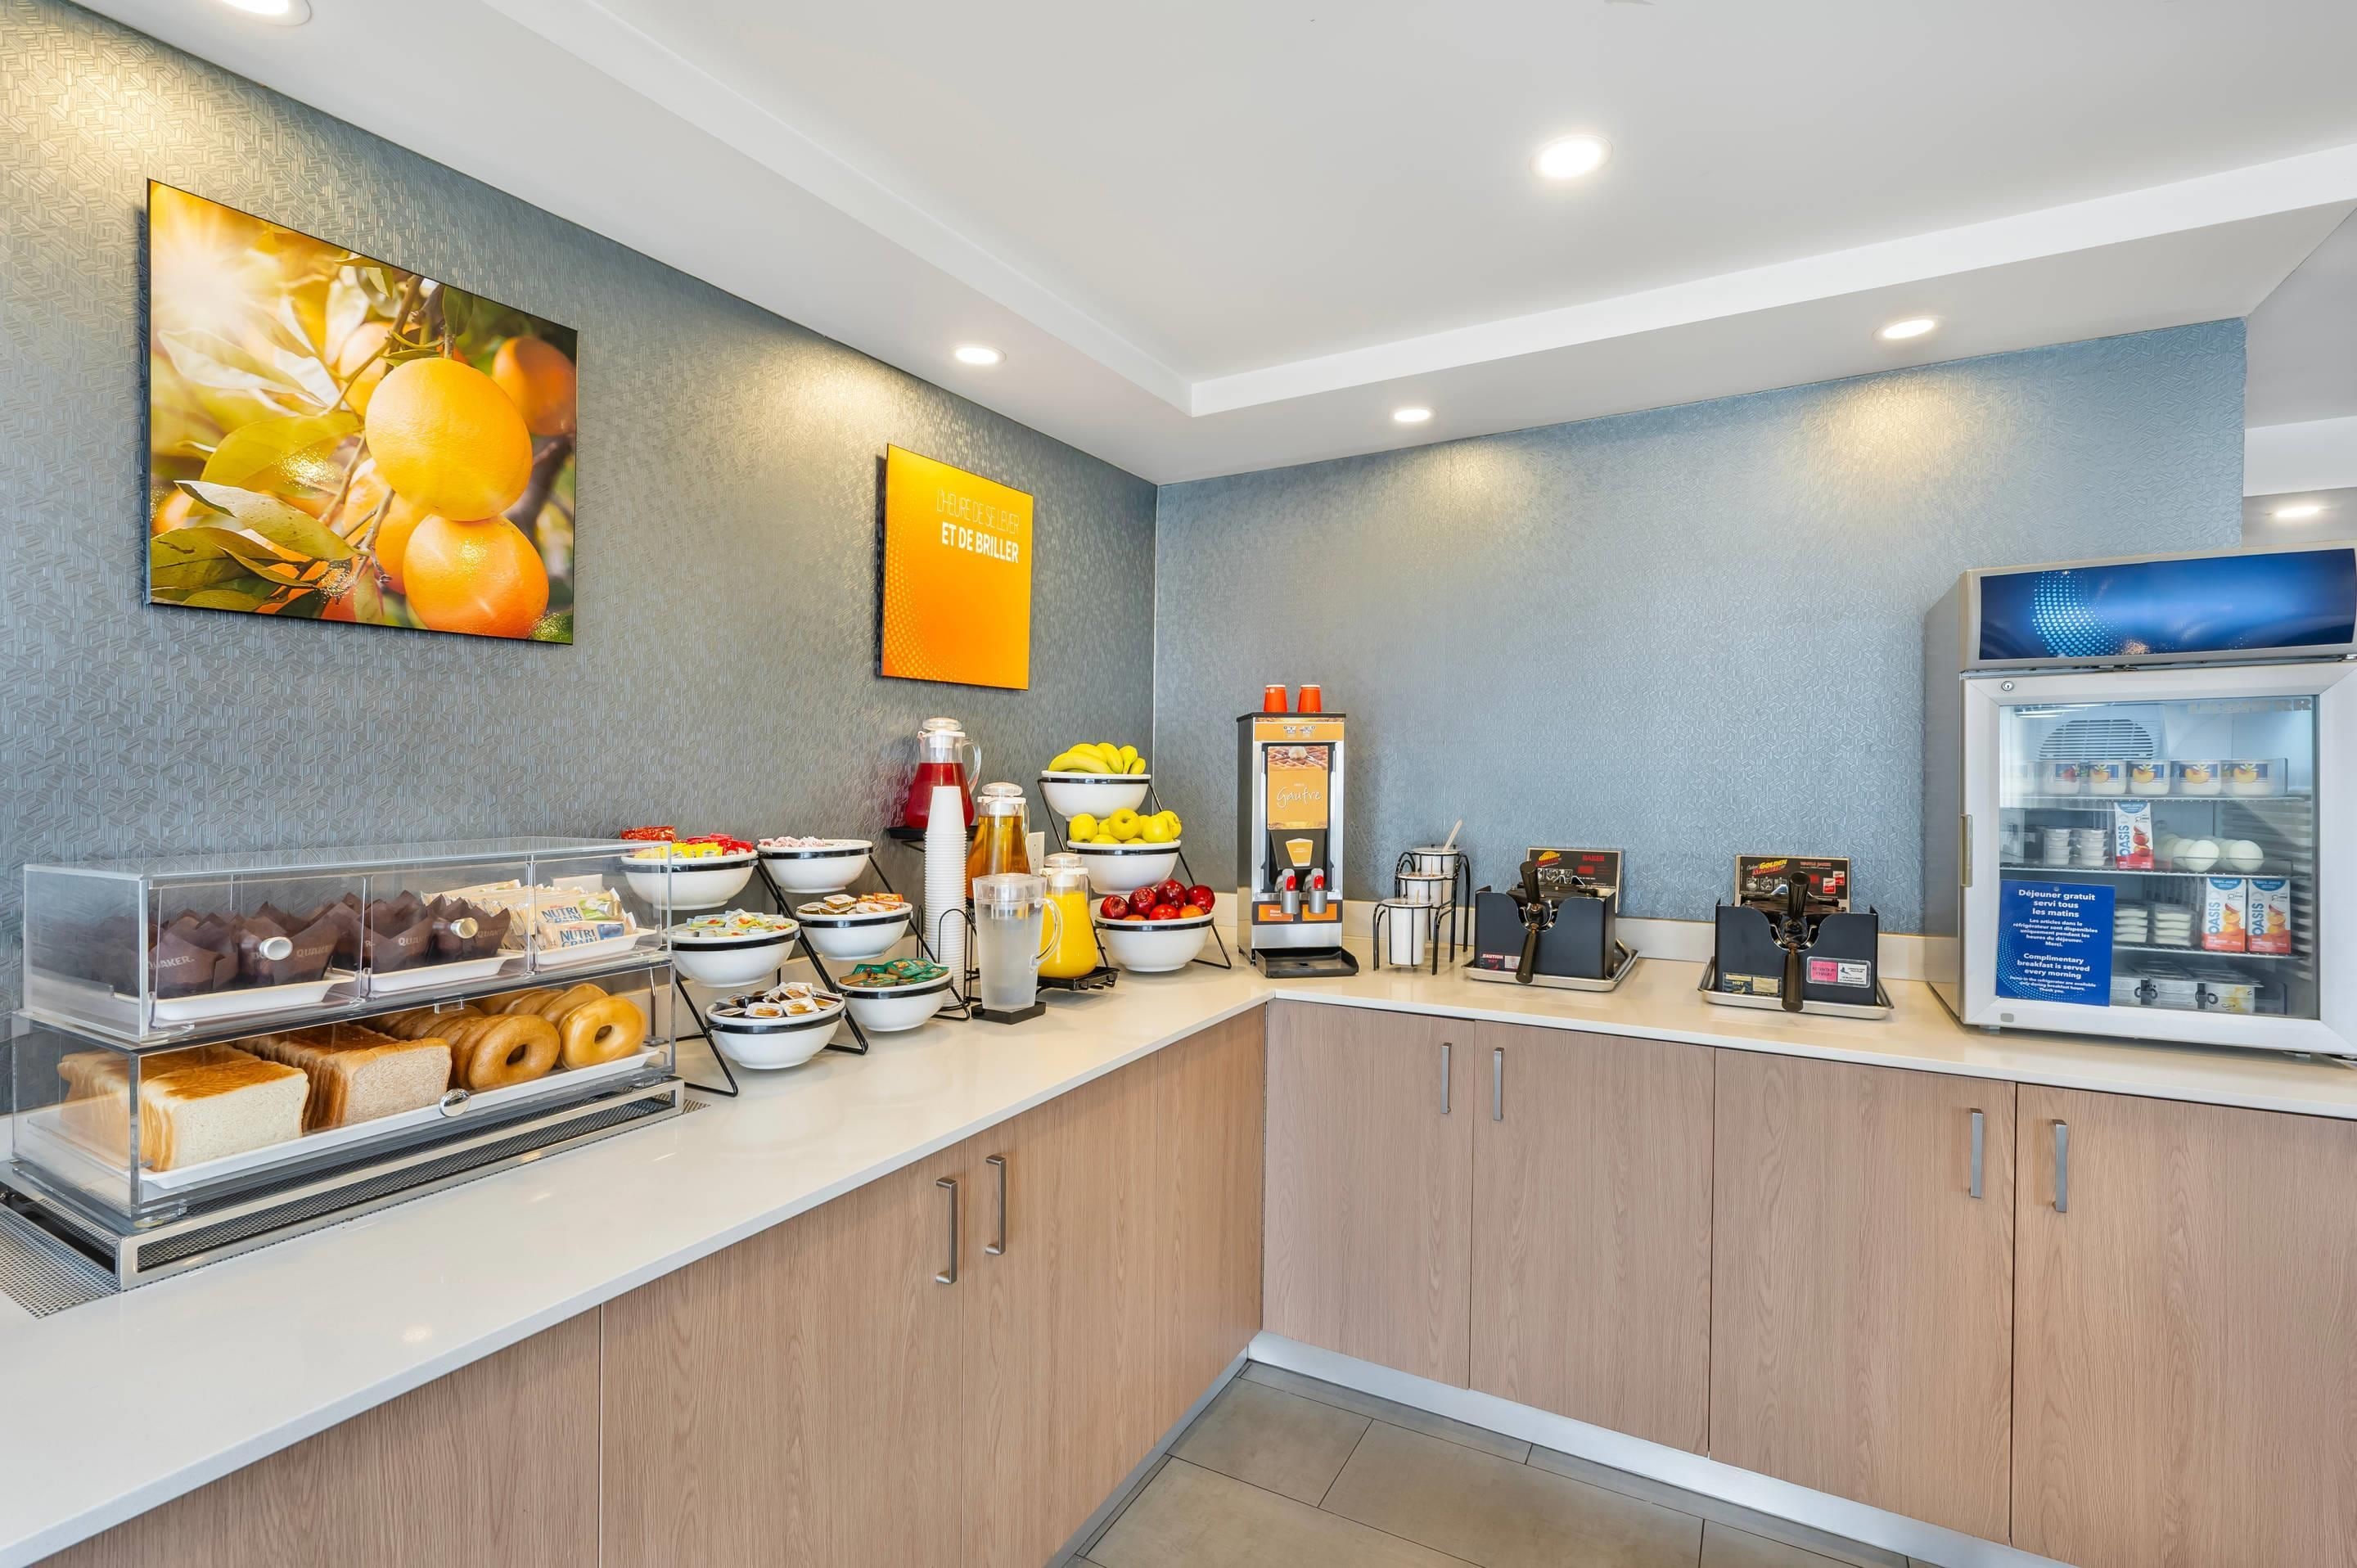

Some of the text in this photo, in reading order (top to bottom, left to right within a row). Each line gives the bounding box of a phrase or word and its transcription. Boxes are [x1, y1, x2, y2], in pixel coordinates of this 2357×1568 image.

[936, 489, 1020, 535] L'HEURE DE SE LEVER
[942, 520, 1019, 564] ET DE BRILLER
[2118, 824, 2131, 857] OASIS
[2018, 890, 2096, 901] Déjeuner gratuit
[541, 906, 579, 921] NUTRI
[2208, 901, 2221, 935] OASIS
[2251, 903, 2265, 936] OASIS
[559, 929, 596, 942] NUTRI
[2017, 960, 2054, 969] breakfast
[2023, 953, 2084, 965] Complimentary
[2024, 969, 2082, 980] every morning
